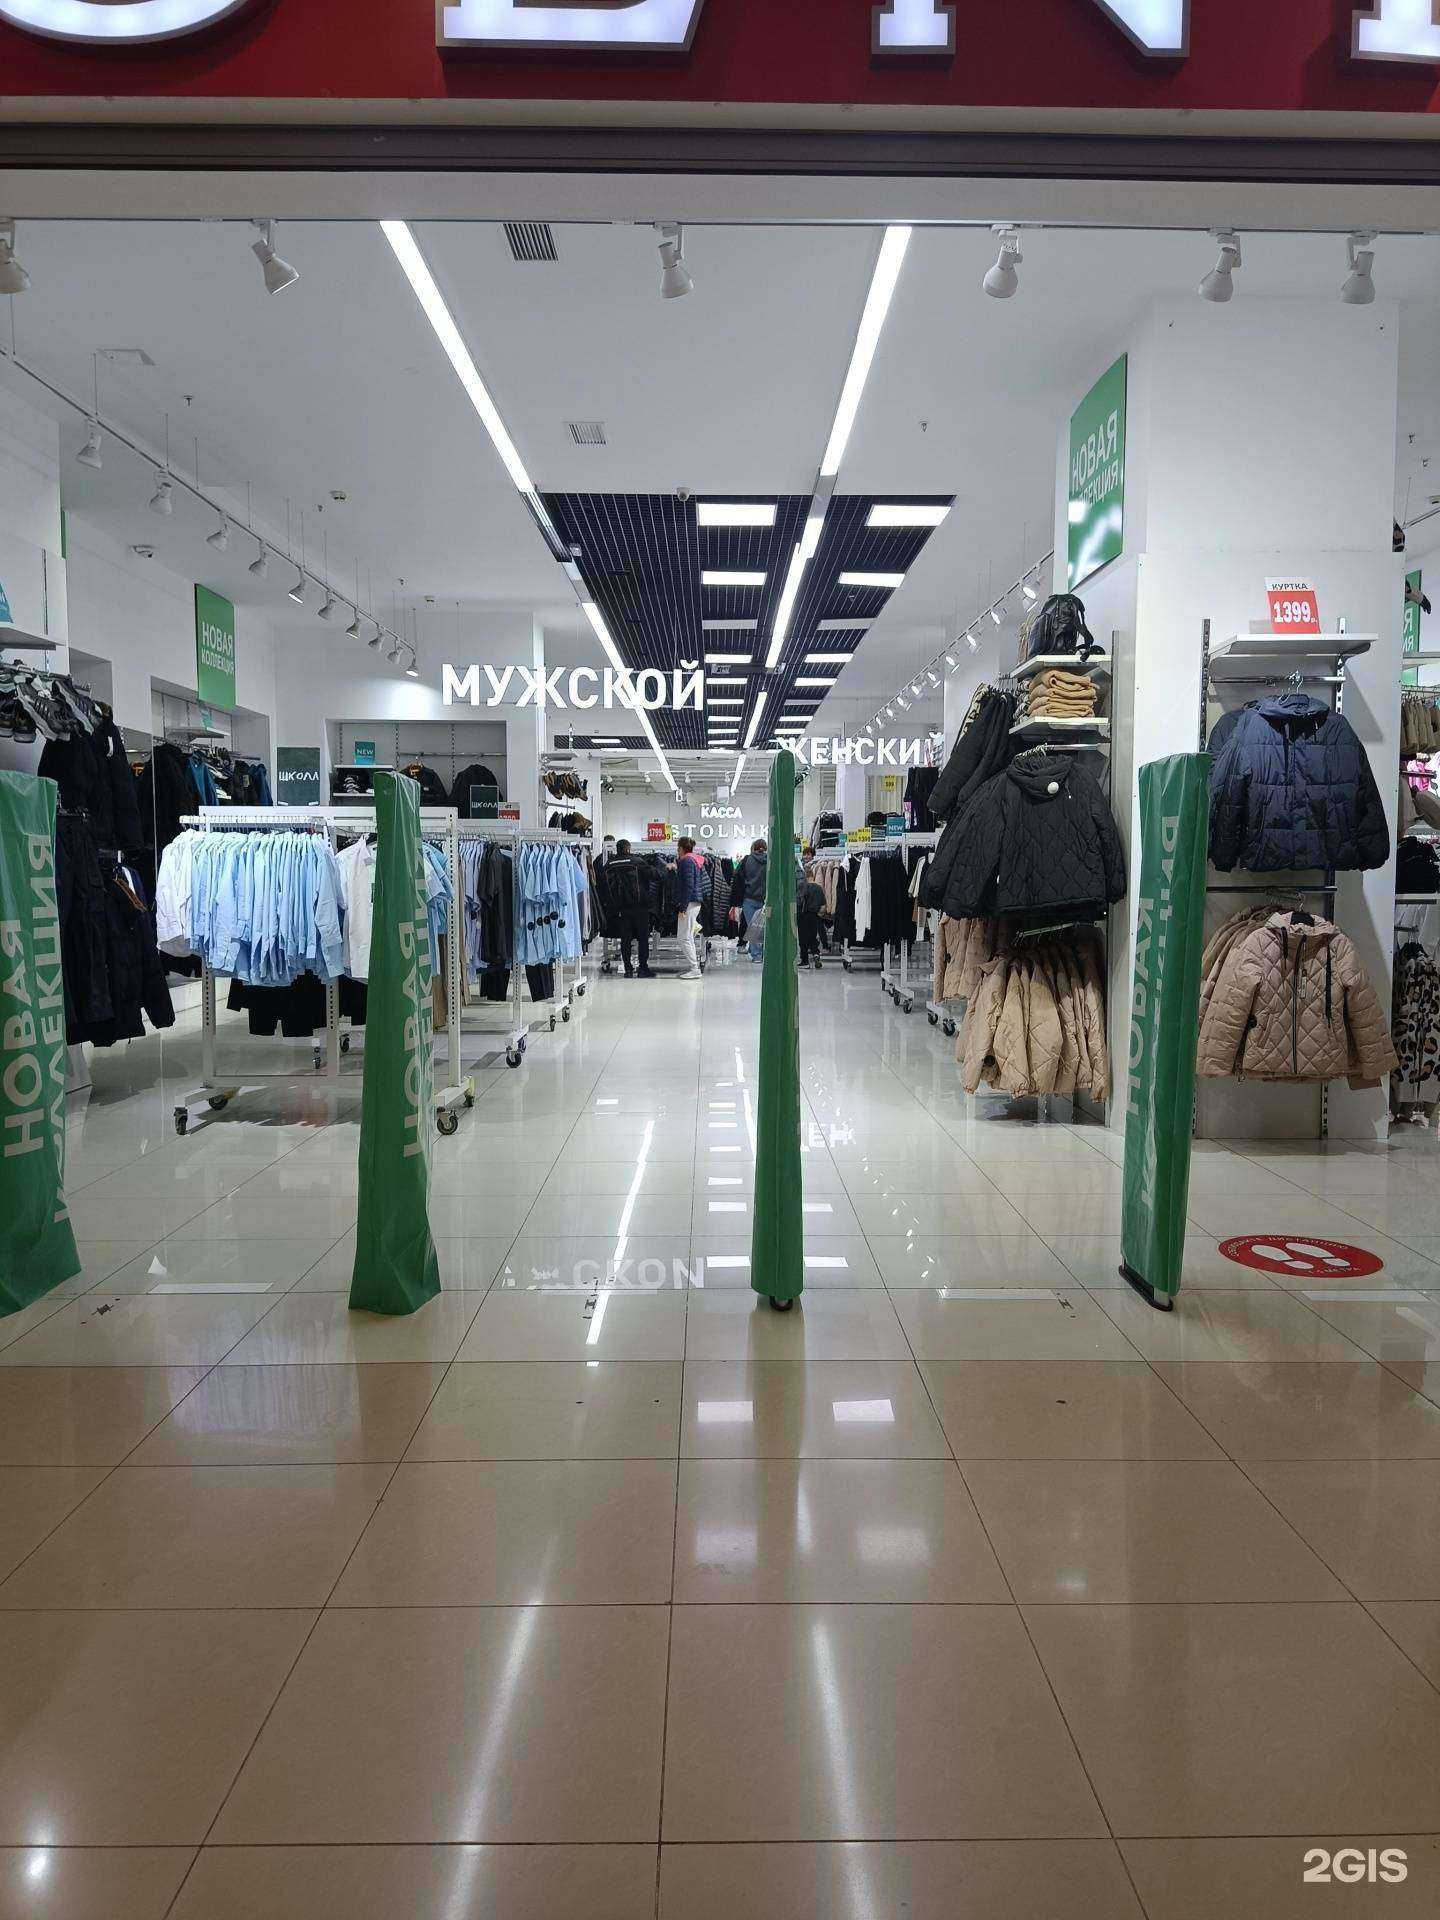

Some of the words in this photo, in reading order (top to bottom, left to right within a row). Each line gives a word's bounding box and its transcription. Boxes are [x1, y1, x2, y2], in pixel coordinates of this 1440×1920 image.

[1072, 409, 1118, 496] НОВАЯ
[202, 621, 233, 658] НОВАЯ
[201, 648, 234, 676] КОЛЛЕКЦИЯ
[442, 659, 704, 710] МУЖСКОЙ
[701, 805, 743, 819] КАССА
[1, 919, 44, 1157] НОВАЯ
